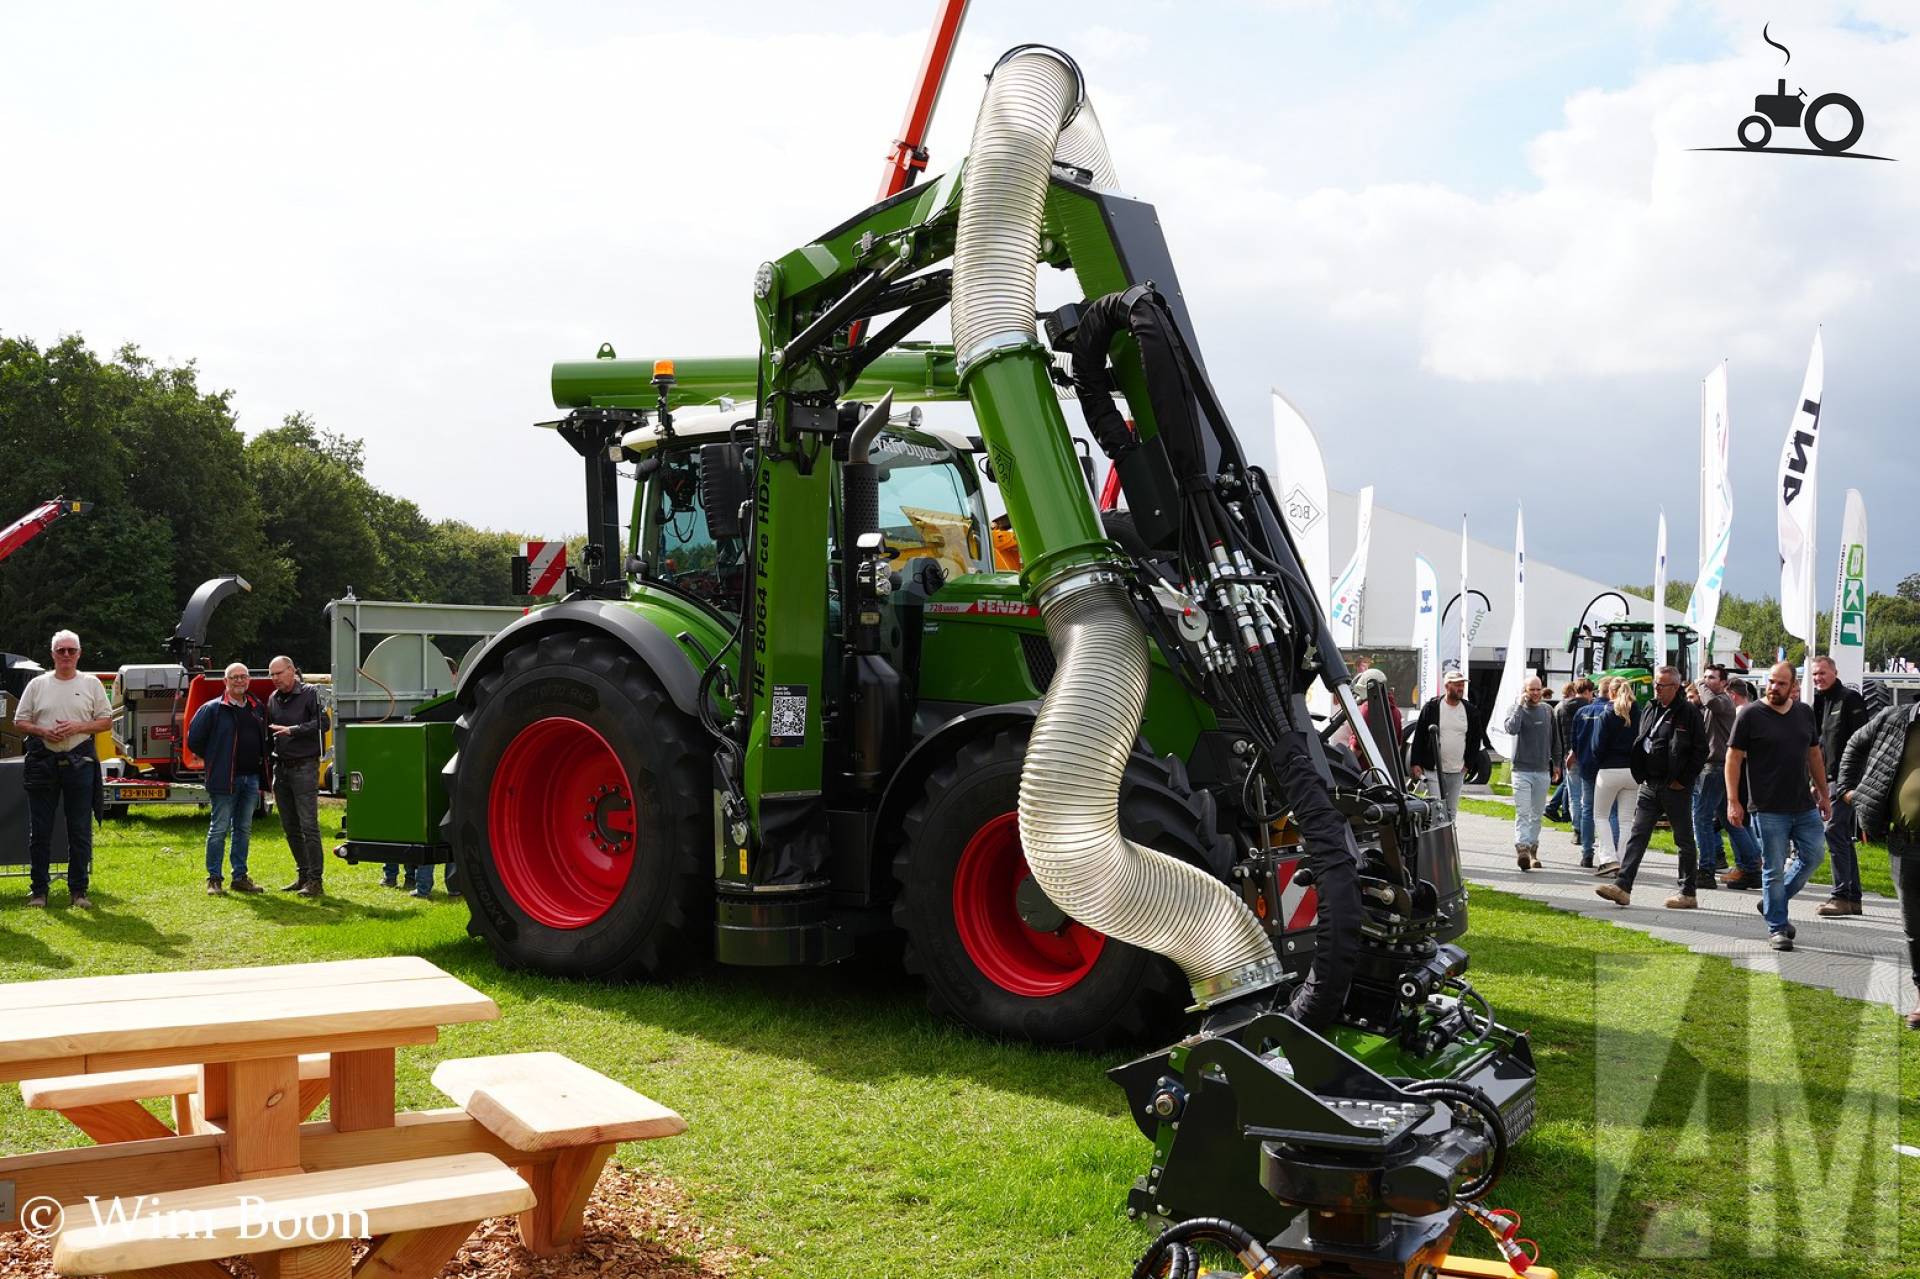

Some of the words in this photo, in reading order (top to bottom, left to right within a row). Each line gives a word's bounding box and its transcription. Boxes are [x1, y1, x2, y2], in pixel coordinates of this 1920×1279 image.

[759, 469, 771, 526] HDa
[757, 534, 769, 578] Fce
[755, 588, 767, 651] 8064
[977, 599, 1030, 615] FENDT
[753, 660, 765, 697] HE
